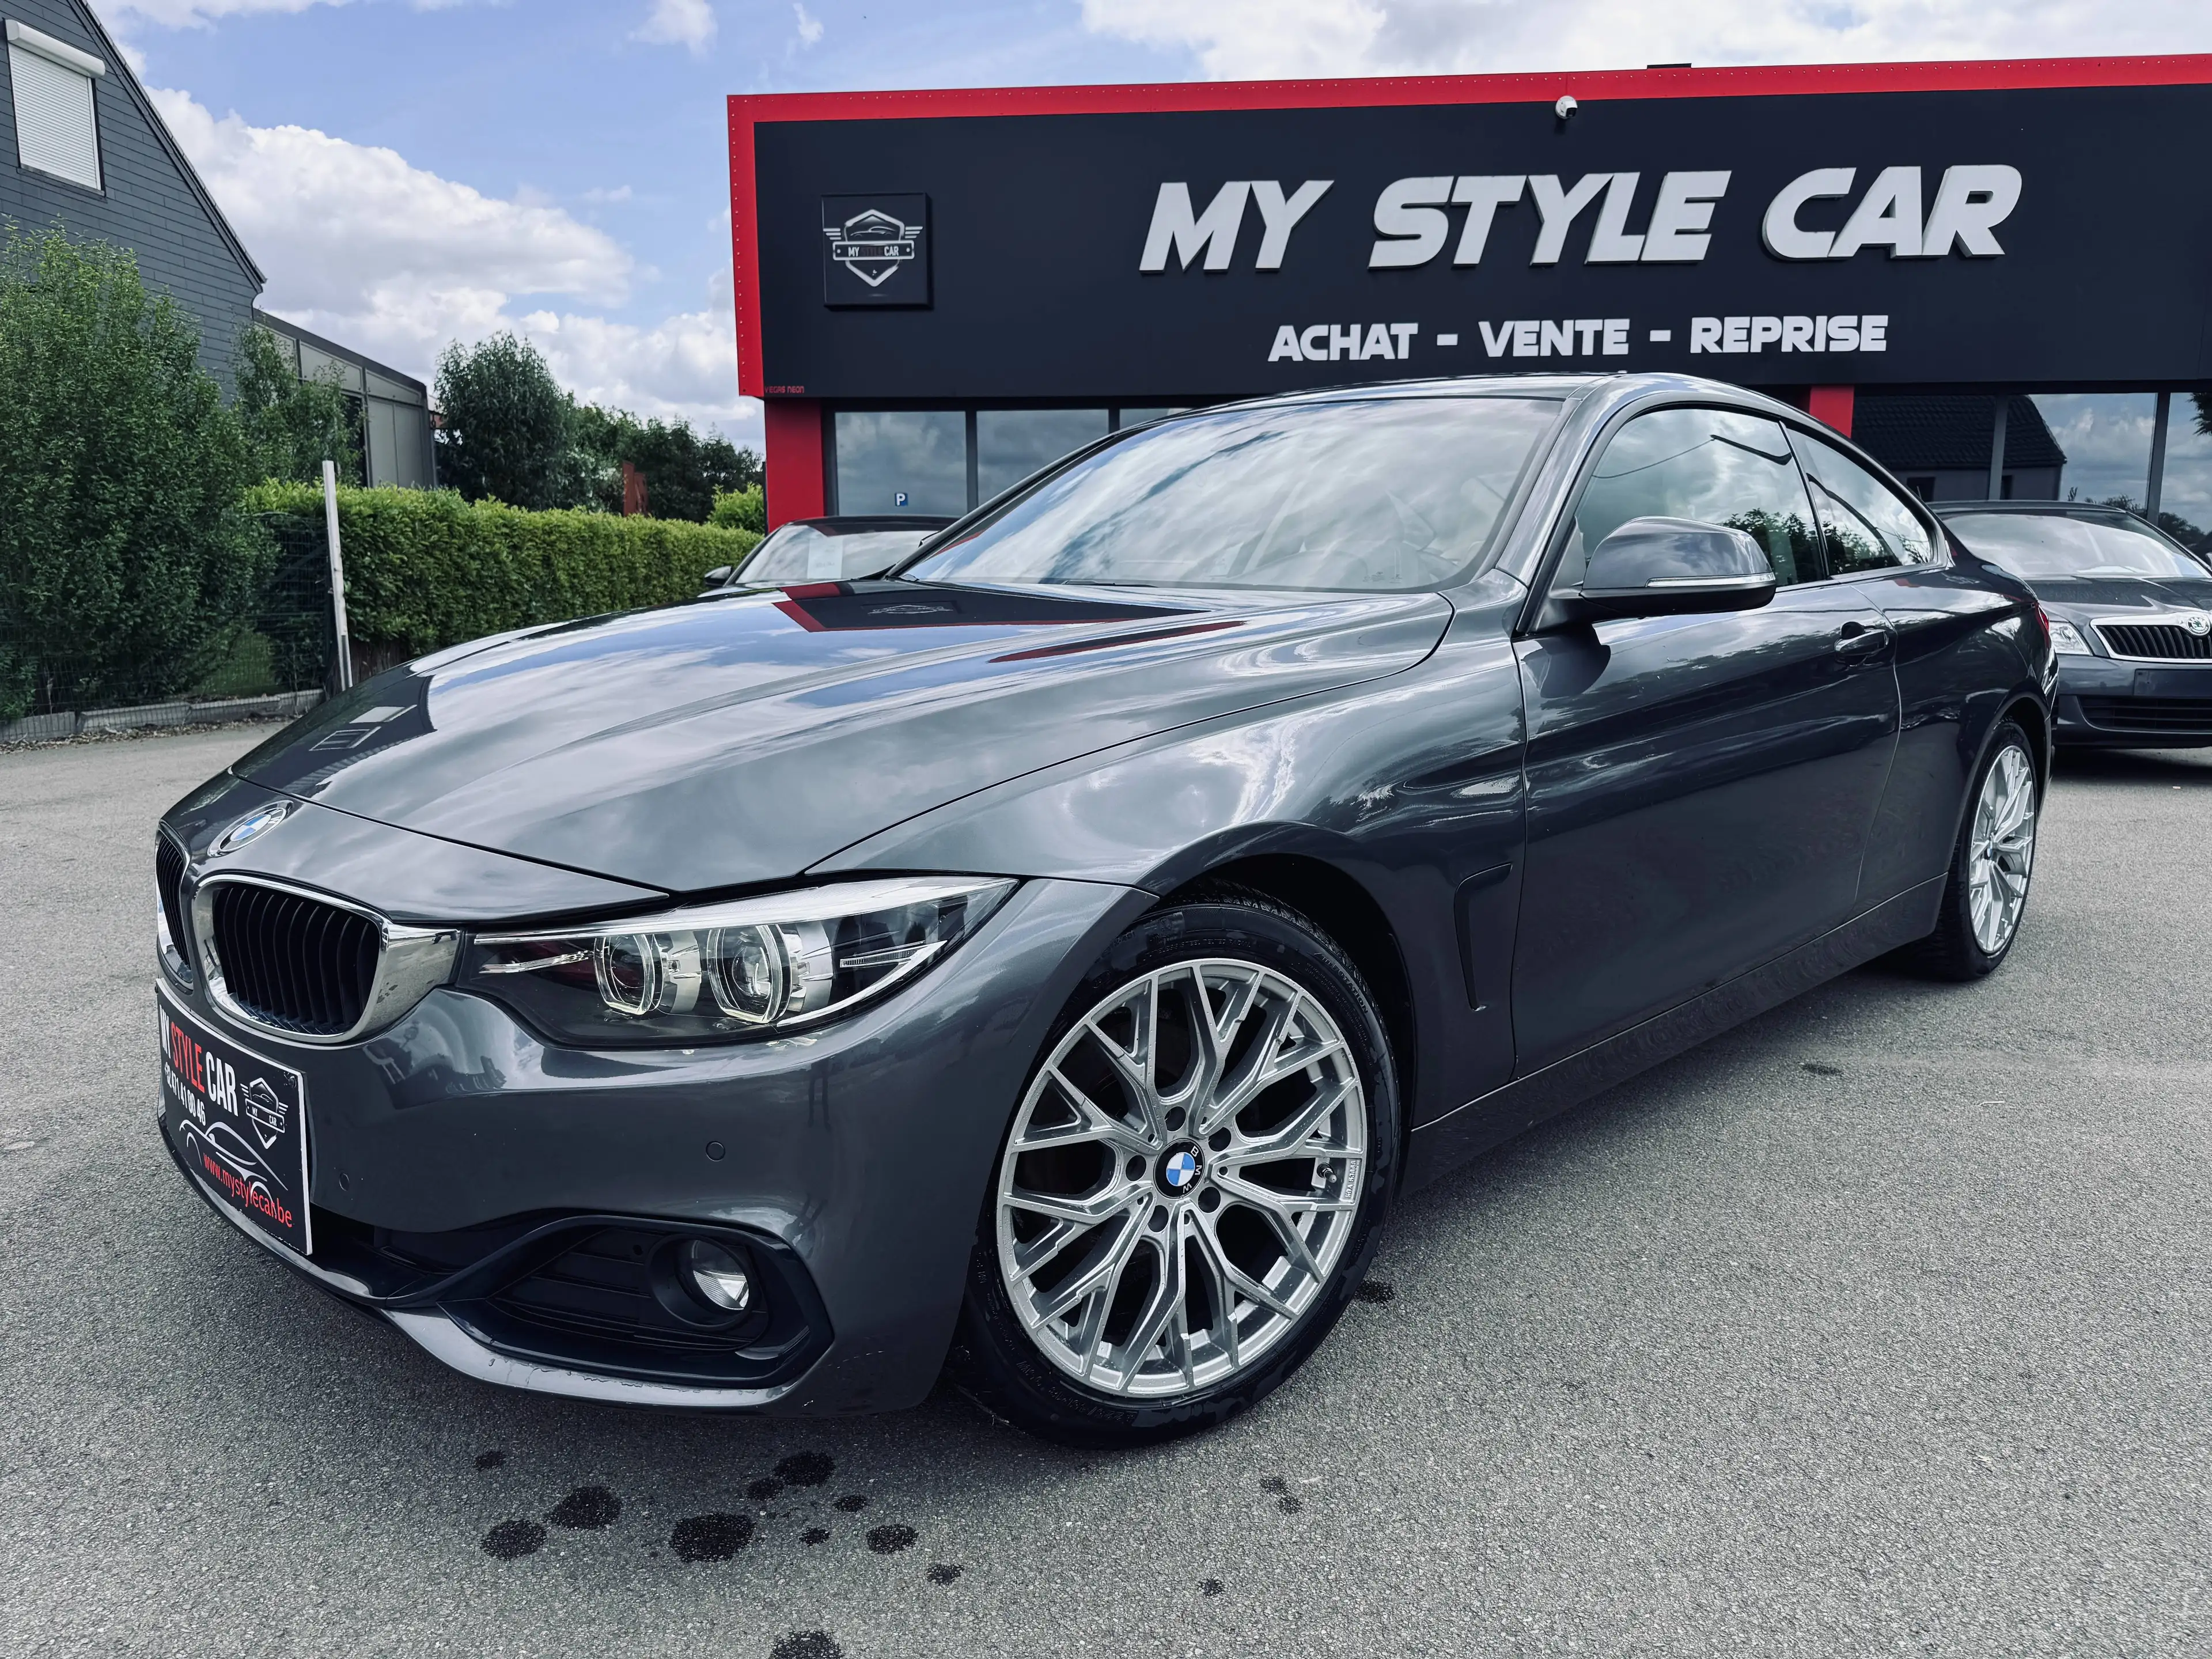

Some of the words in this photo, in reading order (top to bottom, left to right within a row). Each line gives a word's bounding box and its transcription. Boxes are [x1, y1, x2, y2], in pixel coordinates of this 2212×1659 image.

[1139, 180, 1335, 273] MY
[1368, 171, 1732, 270] STYLE
[1762, 164, 2022, 260] CAR
[848, 247, 859, 257] MY
[884, 246, 899, 256] CAR
[1268, 323, 1419, 362] ACHAT
[1437, 334, 1458, 346] -
[1478, 319, 1630, 358] VENTE
[1650, 330, 1671, 342] -
[1690, 315, 1888, 353] REPRISE
[896, 493, 906, 506] P
[159, 1003, 171, 1059] MY
[171, 1021, 205, 1094] STYLE
[206, 1051, 238, 1117] CAR
[171, 1070, 180, 1100] 471
[180, 1082, 188, 1109] 41
[187, 1089, 196, 1118] 00
[197, 1098, 206, 1126] 46
[203, 1153, 293, 1228] www.mystylecar.be
[1183, 1145, 1202, 1194] BMW
